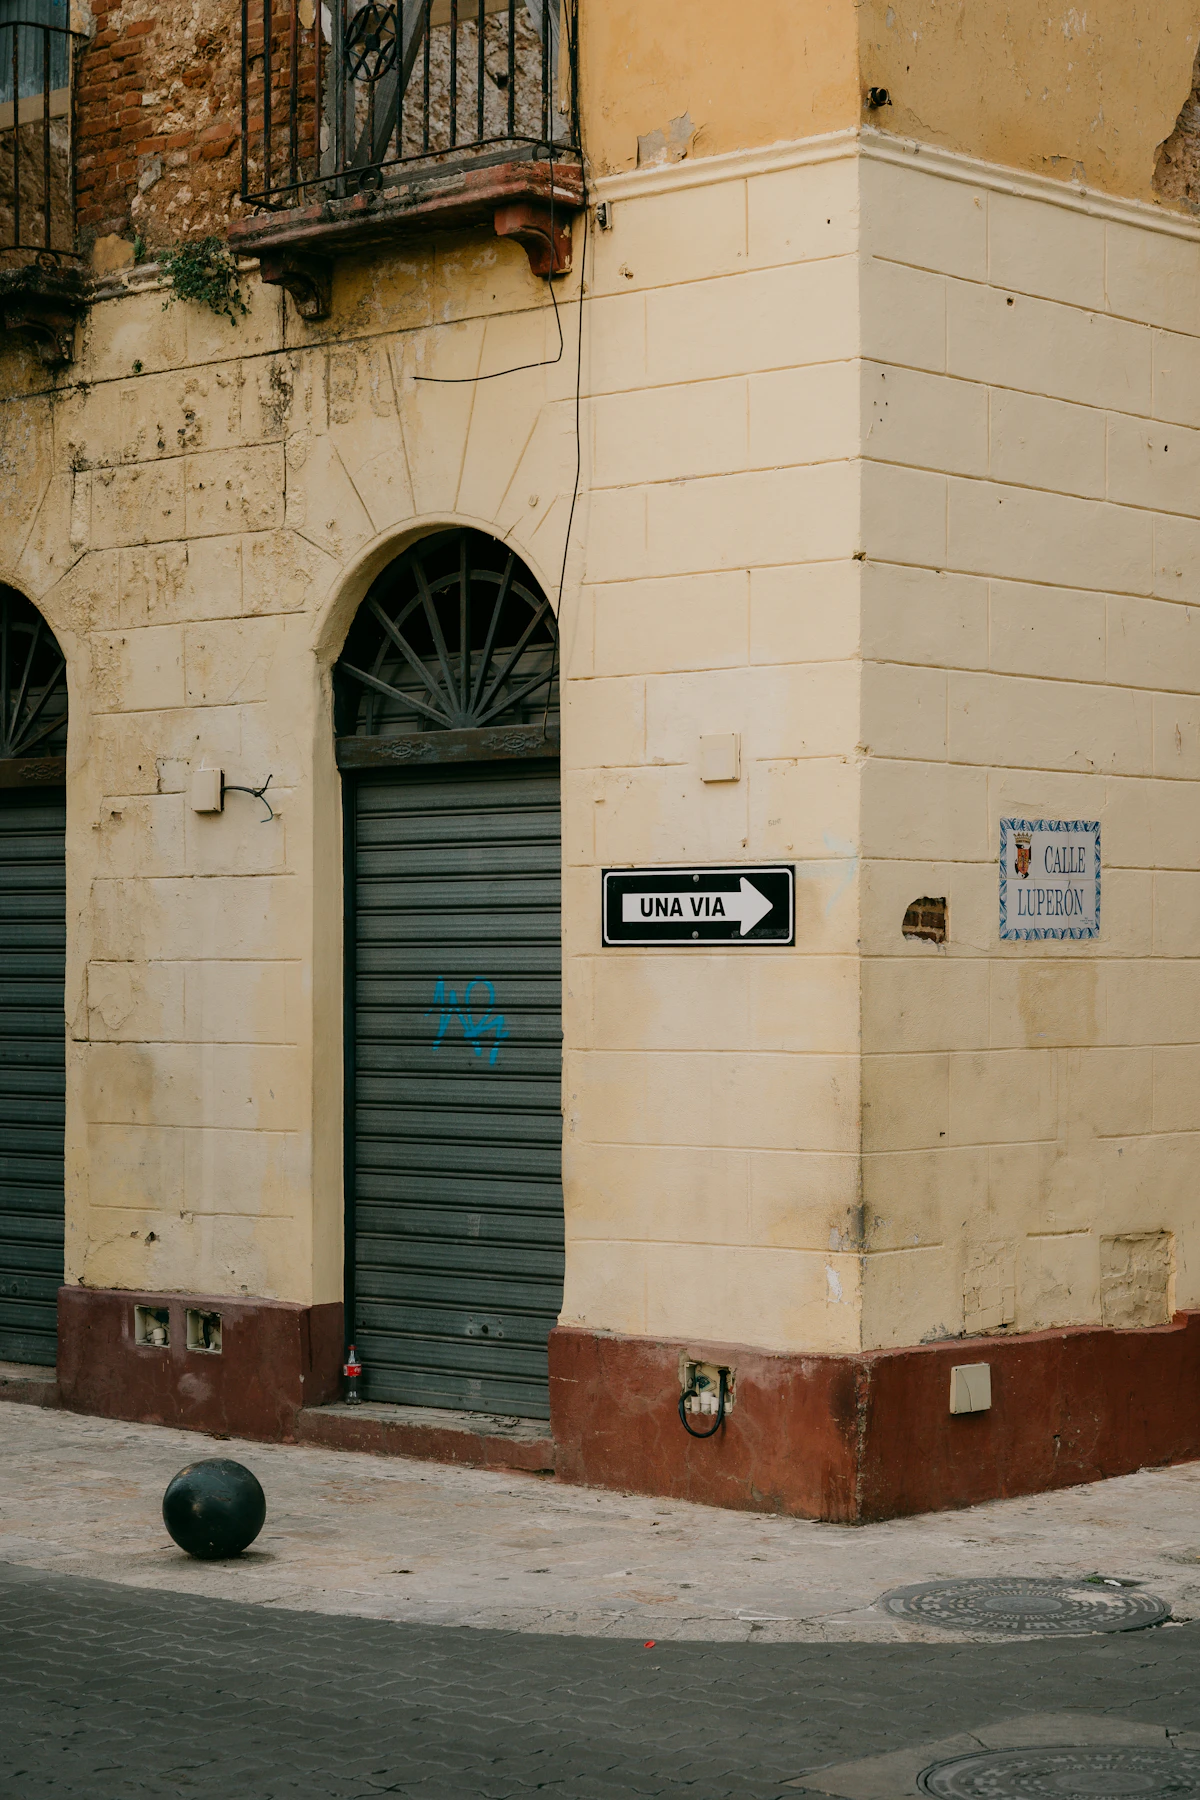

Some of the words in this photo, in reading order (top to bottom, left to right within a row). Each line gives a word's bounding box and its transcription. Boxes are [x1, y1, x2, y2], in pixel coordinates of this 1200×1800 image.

[1045, 846, 1086, 873] CALLE
[641, 898, 683, 917] UNA
[690, 897, 725, 917] VIA
[1018, 881, 1084, 916] LUPERÓN
